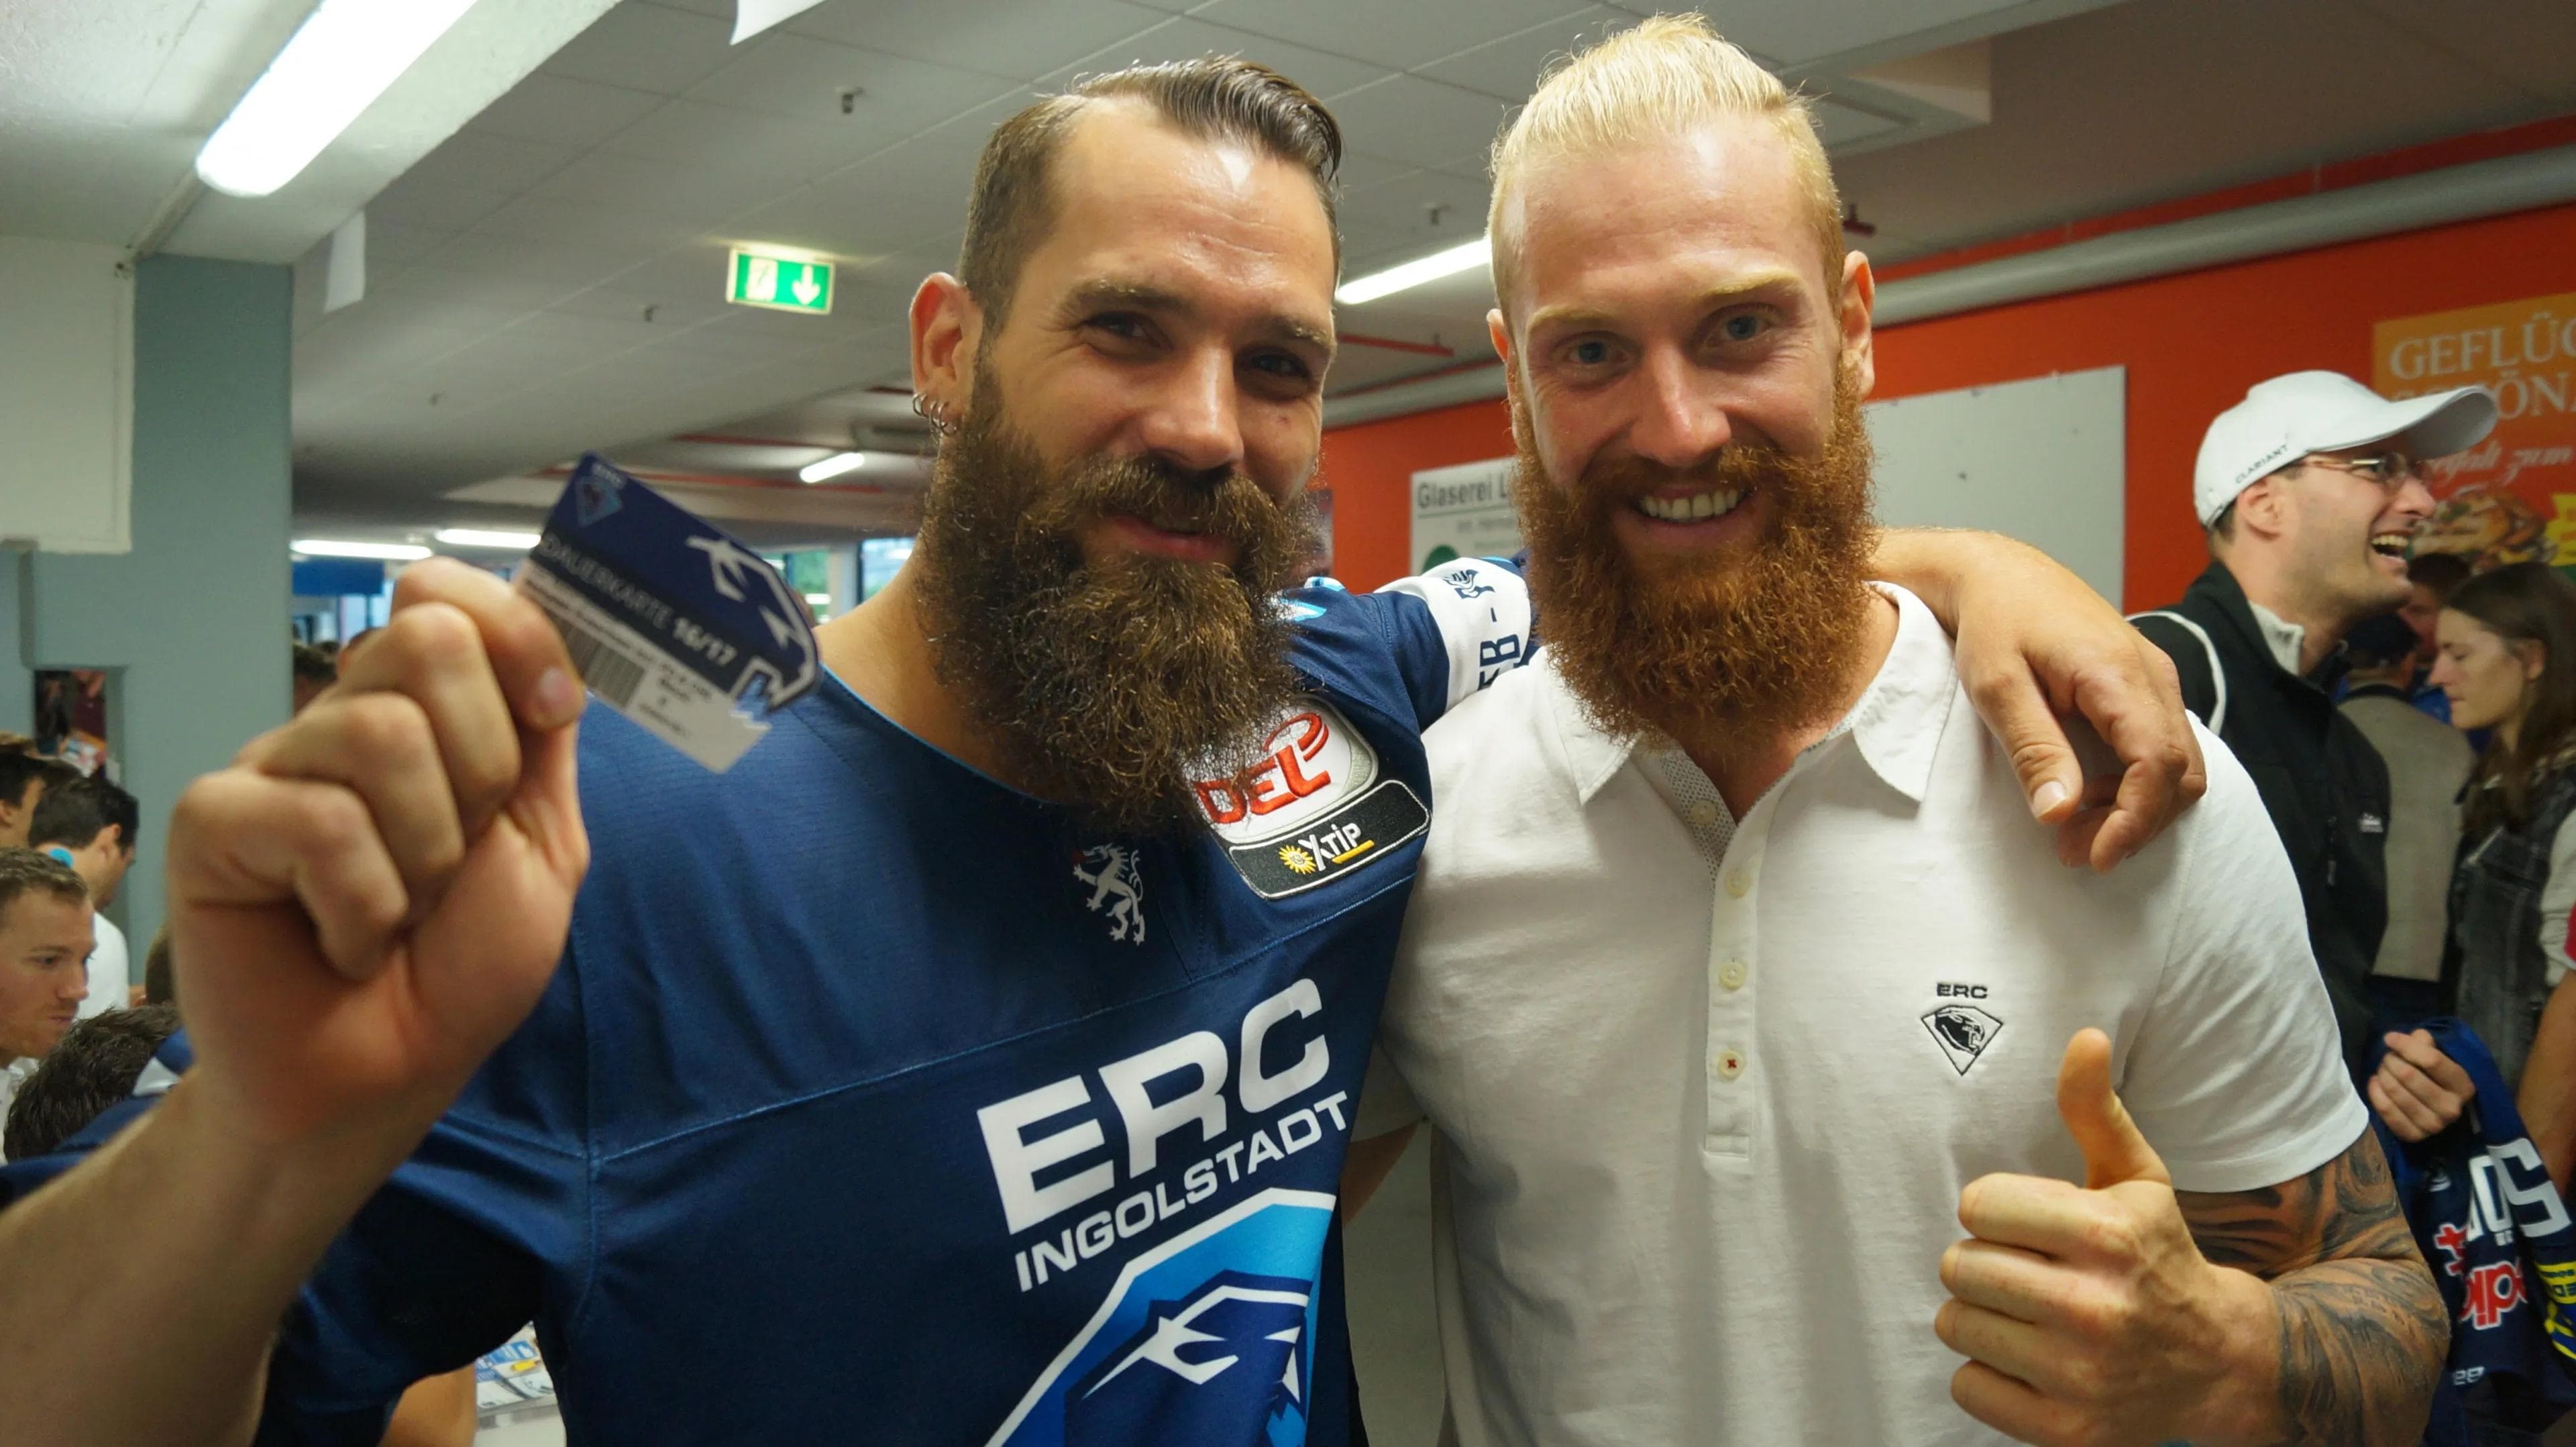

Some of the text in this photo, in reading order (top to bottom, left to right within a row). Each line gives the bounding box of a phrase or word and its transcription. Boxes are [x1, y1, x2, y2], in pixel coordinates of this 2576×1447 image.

[1417, 474, 1493, 508] Glaserei
[2235, 444, 2287, 483] CLARIANT
[539, 535, 673, 630] DAUERKARTE
[673, 617, 737, 667] 16/17
[1193, 744, 1331, 824] DEL
[1937, 983, 1988, 999] ERC
[977, 978, 1330, 1235] ERC
[1014, 1090, 1348, 1292] INGOLSTADT
